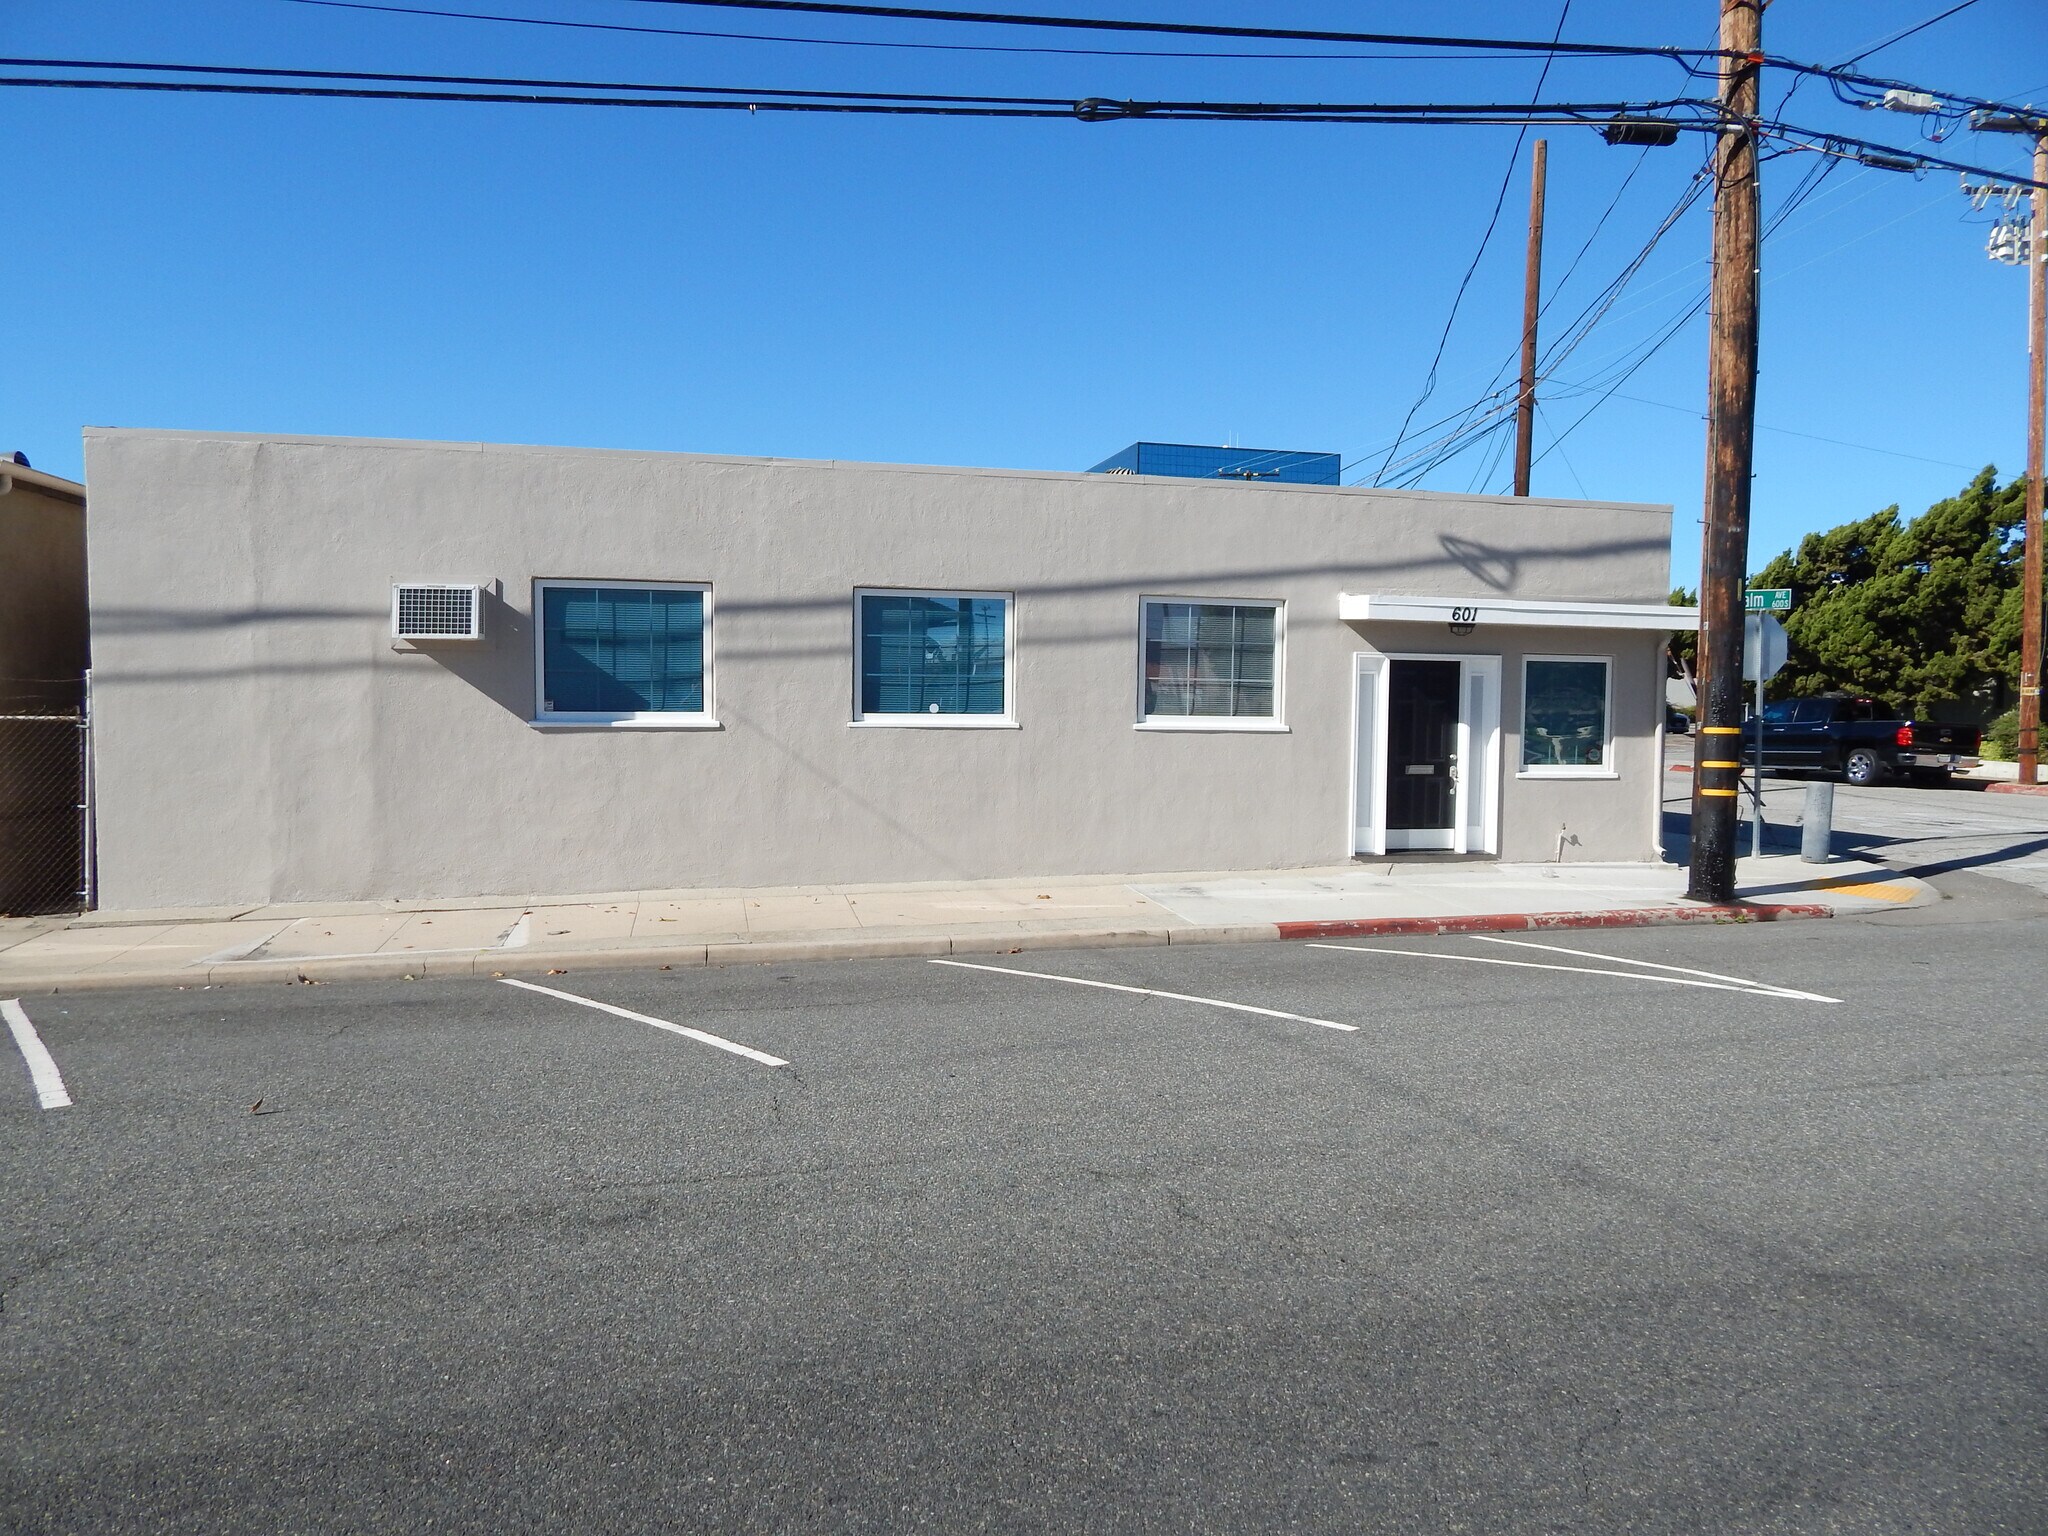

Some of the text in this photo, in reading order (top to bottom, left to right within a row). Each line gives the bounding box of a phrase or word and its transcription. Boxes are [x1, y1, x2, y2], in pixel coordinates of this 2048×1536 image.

[1745, 591, 1787, 608] alm AVE
[1452, 606, 1478, 621] 601
